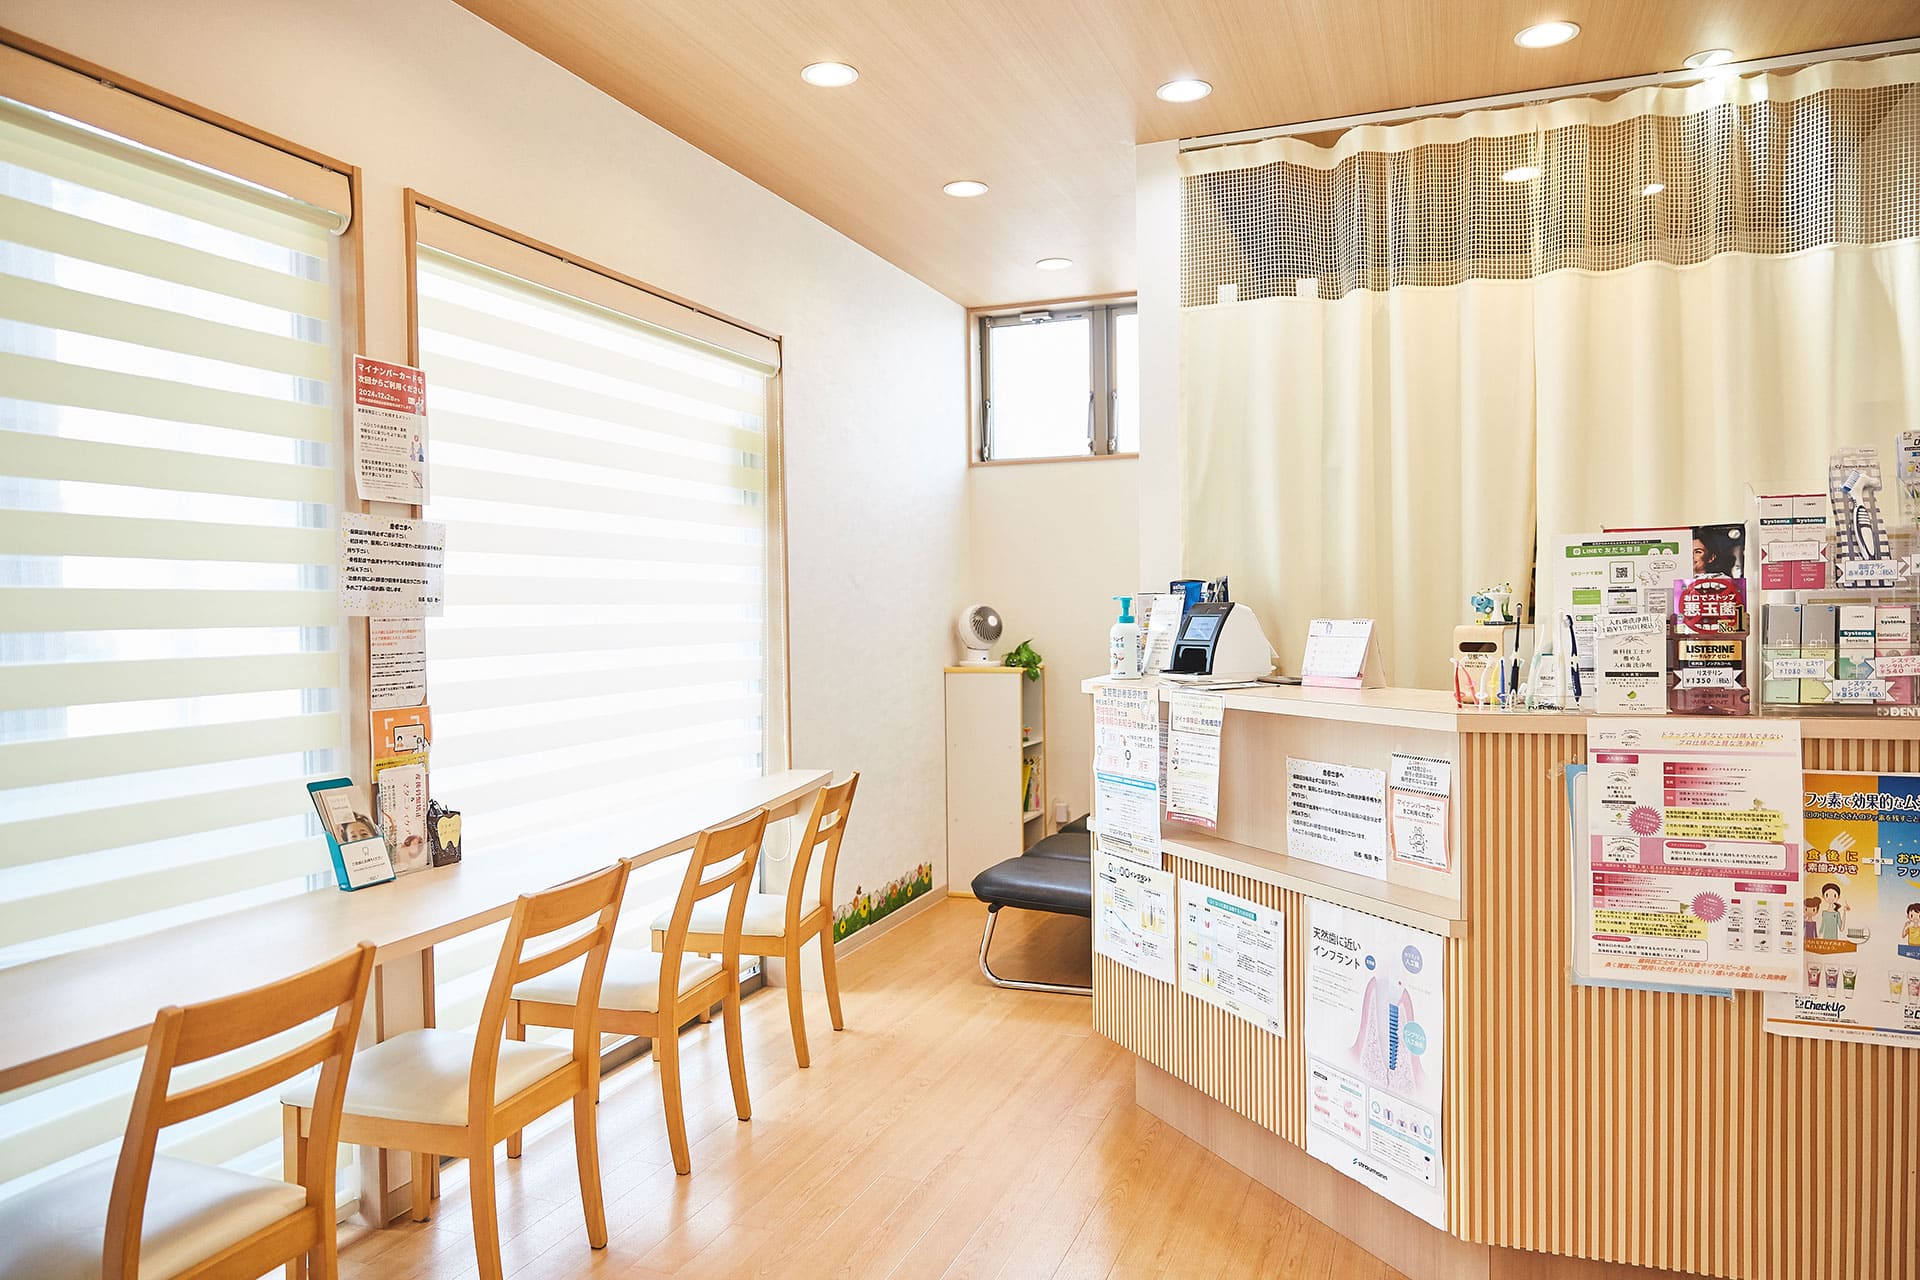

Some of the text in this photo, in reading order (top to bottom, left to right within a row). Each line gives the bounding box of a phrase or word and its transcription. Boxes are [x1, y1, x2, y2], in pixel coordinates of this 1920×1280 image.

[1683, 601, 1736, 617] 悪玉菌
[1686, 645, 1735, 654] LISTERINE
[1807, 849, 1858, 862] 食後に
[1804, 863, 1858, 875] 素歯みがき
[1313, 926, 1361, 952] 天然歯に近い
[1313, 945, 1361, 970] インプラント
